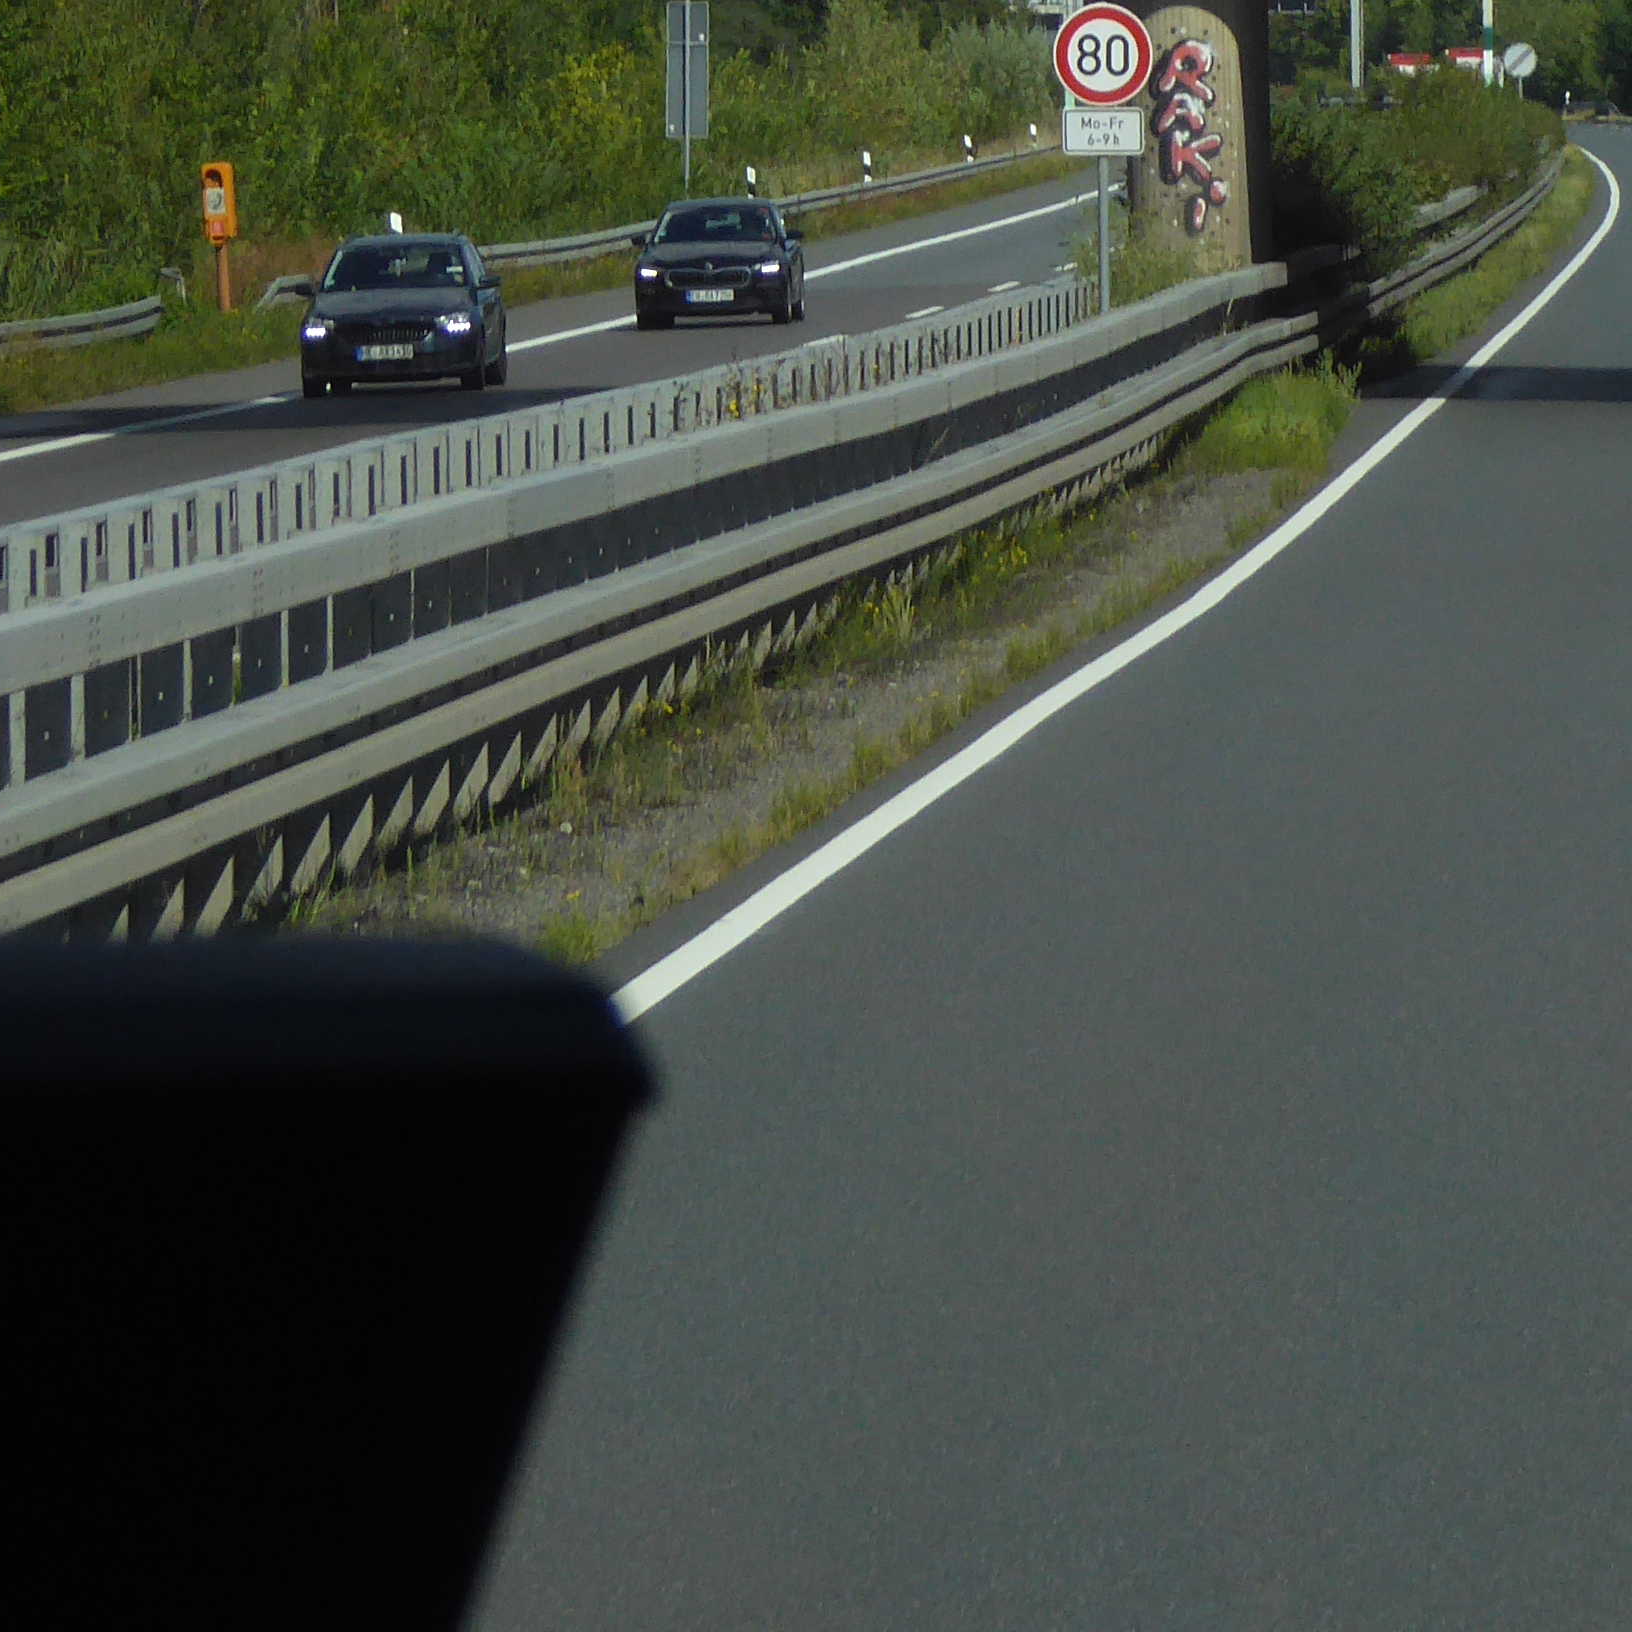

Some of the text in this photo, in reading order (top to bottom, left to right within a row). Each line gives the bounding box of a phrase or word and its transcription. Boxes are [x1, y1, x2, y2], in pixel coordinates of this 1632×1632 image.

[1076, 34, 1130, 76] 80
[1081, 116, 1124, 129] Mo-Fr
[1087, 132, 1120, 147] 6-9 h
